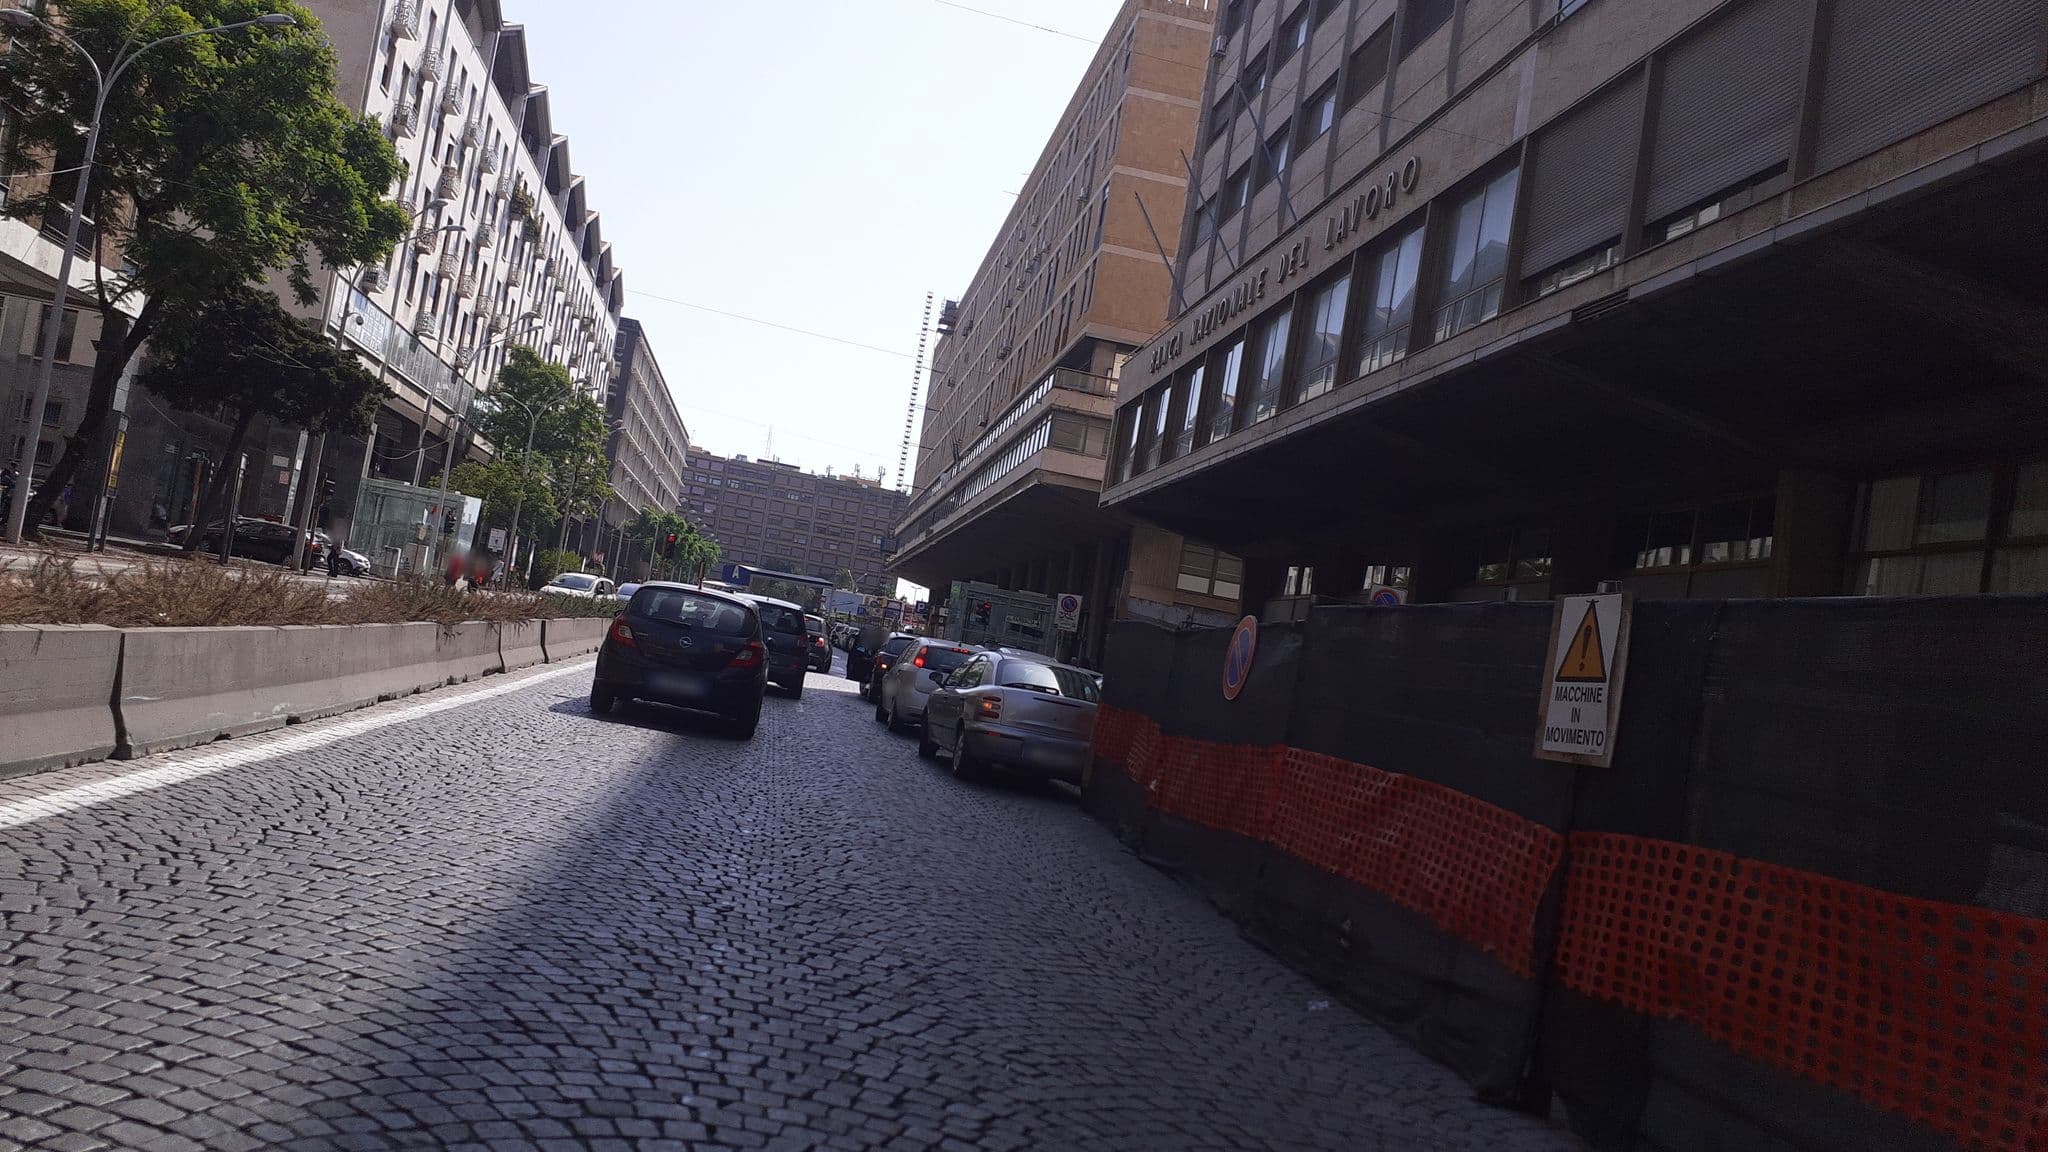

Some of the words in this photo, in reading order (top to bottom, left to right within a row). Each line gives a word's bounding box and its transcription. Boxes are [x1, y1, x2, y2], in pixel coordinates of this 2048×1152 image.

[1278, 236, 1310, 283] DEL
[1324, 155, 1421, 249] LAVORO
[732, 565, 740, 579] A
[917, 603, 925, 613] P
[1554, 686, 1603, 703] MACCHINE
[1571, 707, 1581, 723] IN
[1546, 727, 1604, 746] MOVIMENTO
